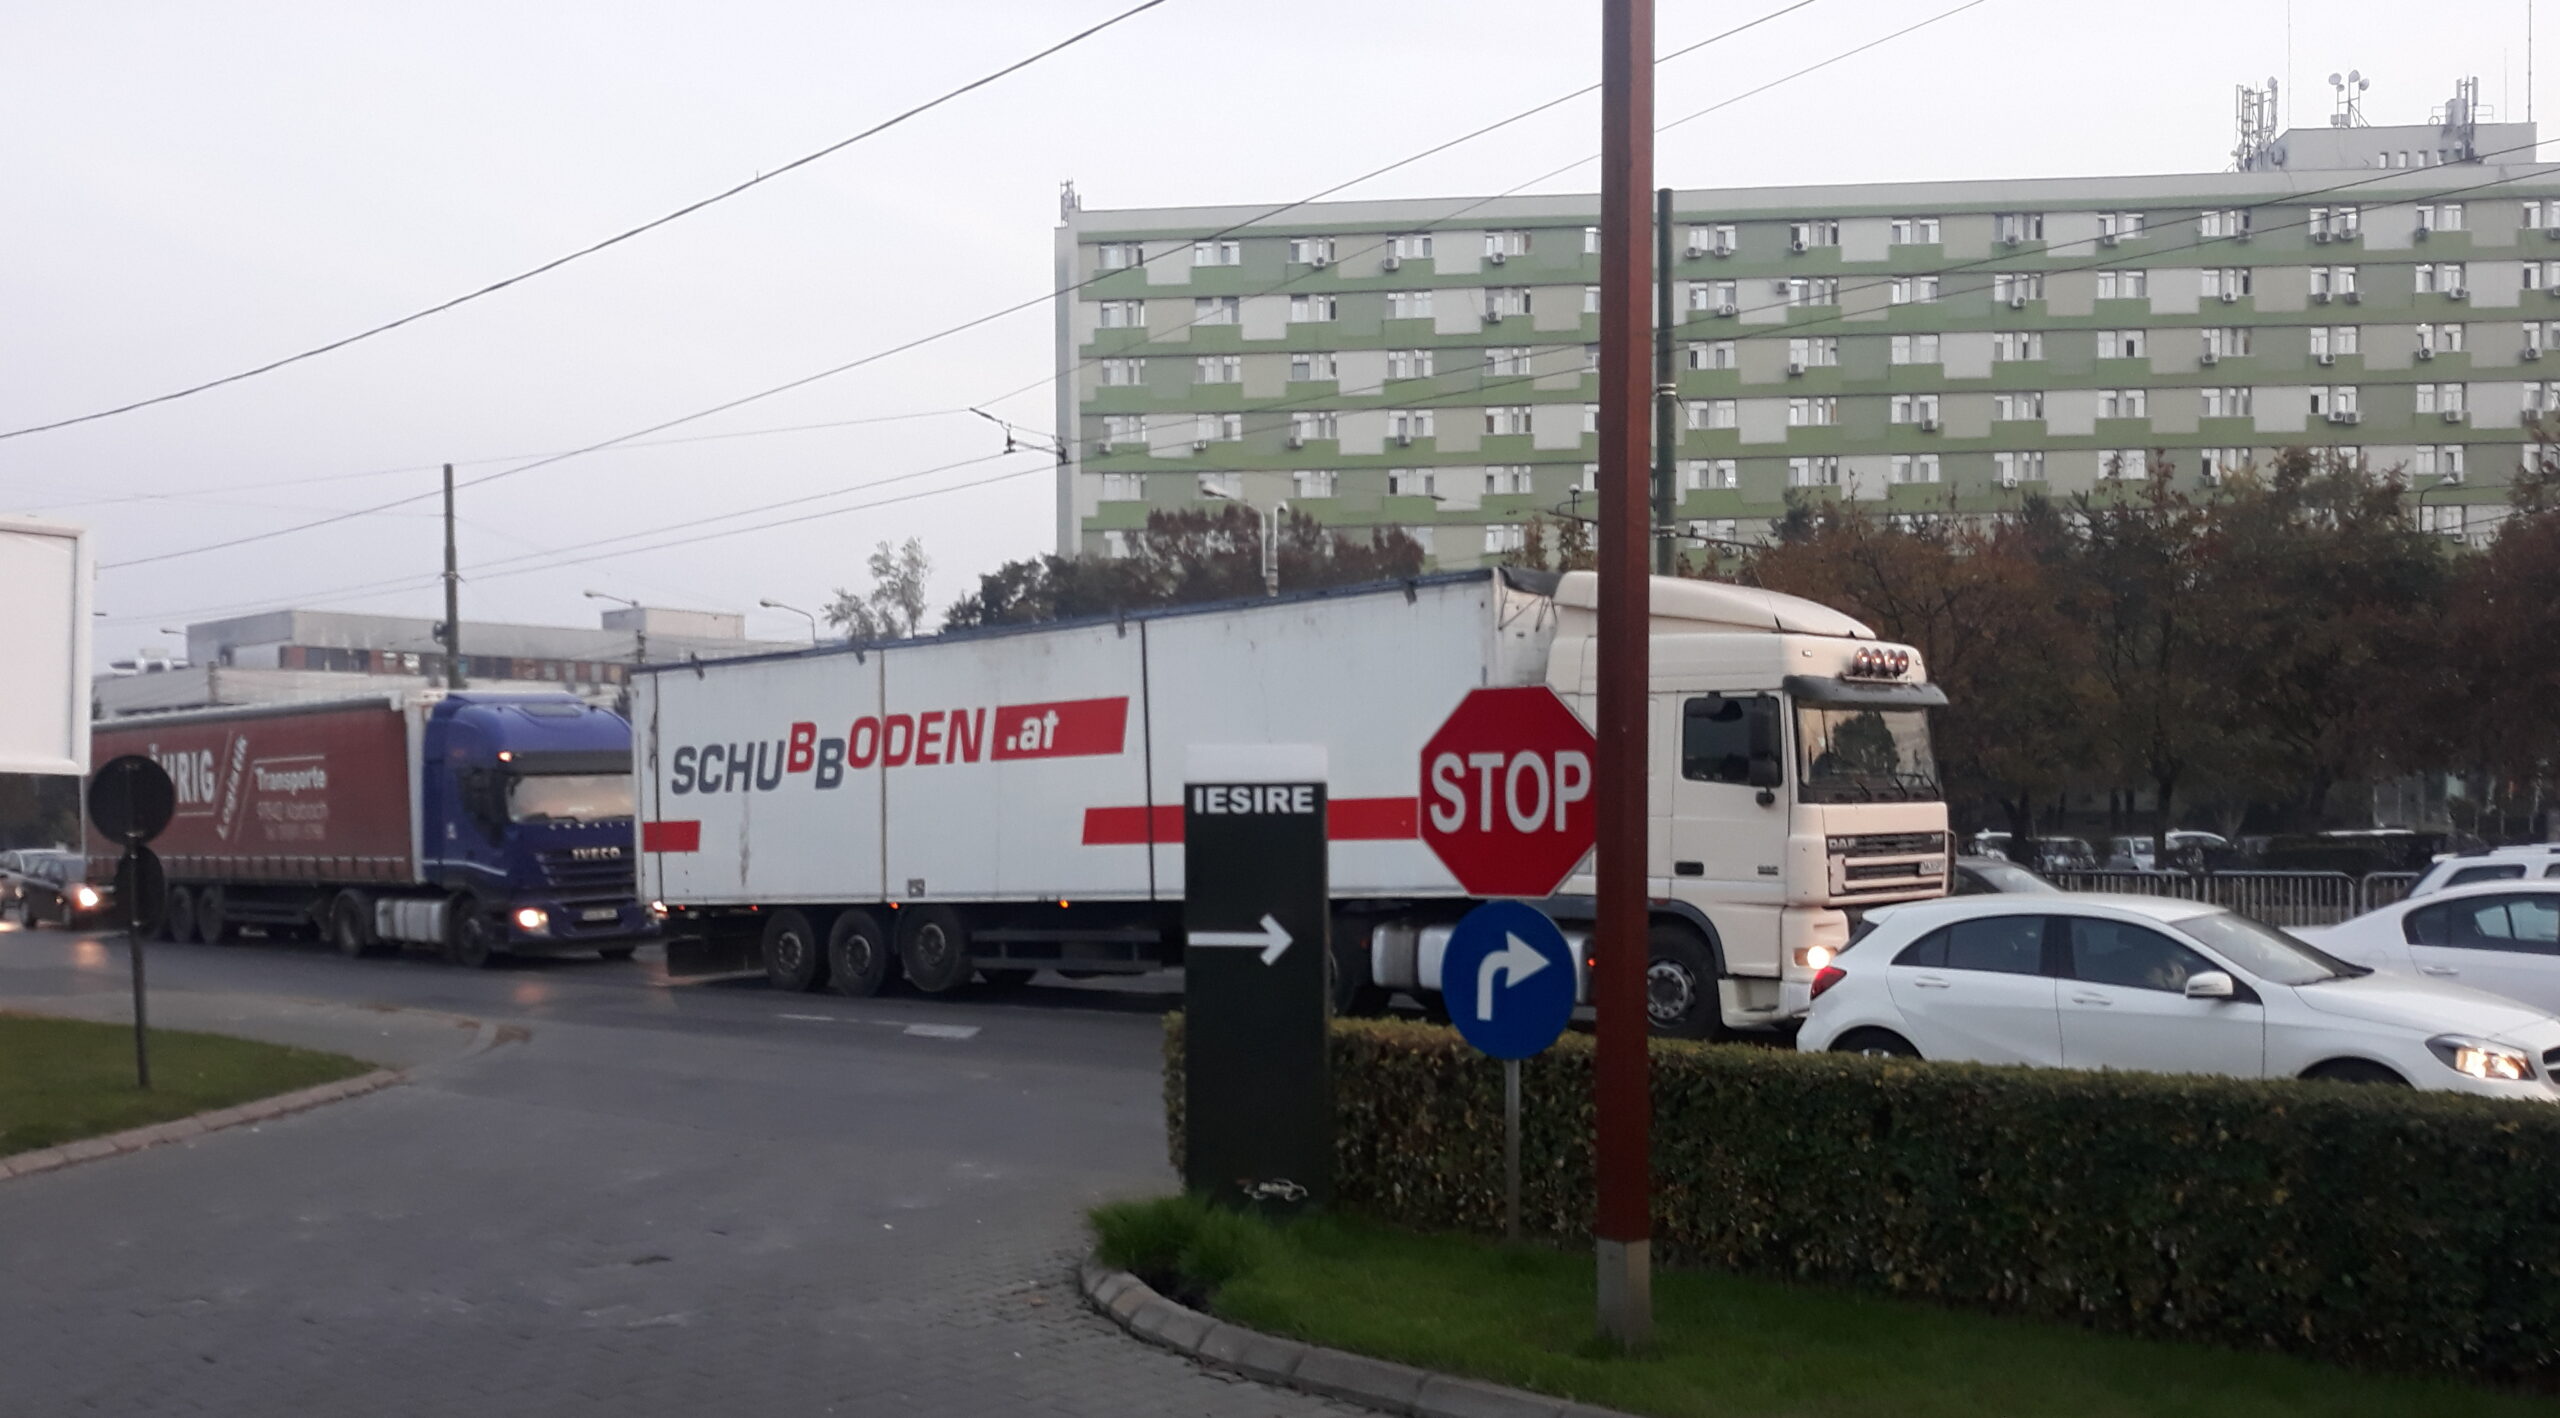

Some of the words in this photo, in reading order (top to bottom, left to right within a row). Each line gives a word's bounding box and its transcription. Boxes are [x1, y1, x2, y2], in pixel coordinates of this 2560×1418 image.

[671, 707, 987, 795] SCHUBBODEN
[1006, 709, 1060, 751] .at
[149, 744, 216, 804] RIG
[254, 766, 327, 796] Transporte
[1193, 786, 1315, 815] IESIRE
[1430, 750, 1591, 834] STOP
[572, 846, 621, 860] IVECO
[1827, 837, 1856, 849] DAF
